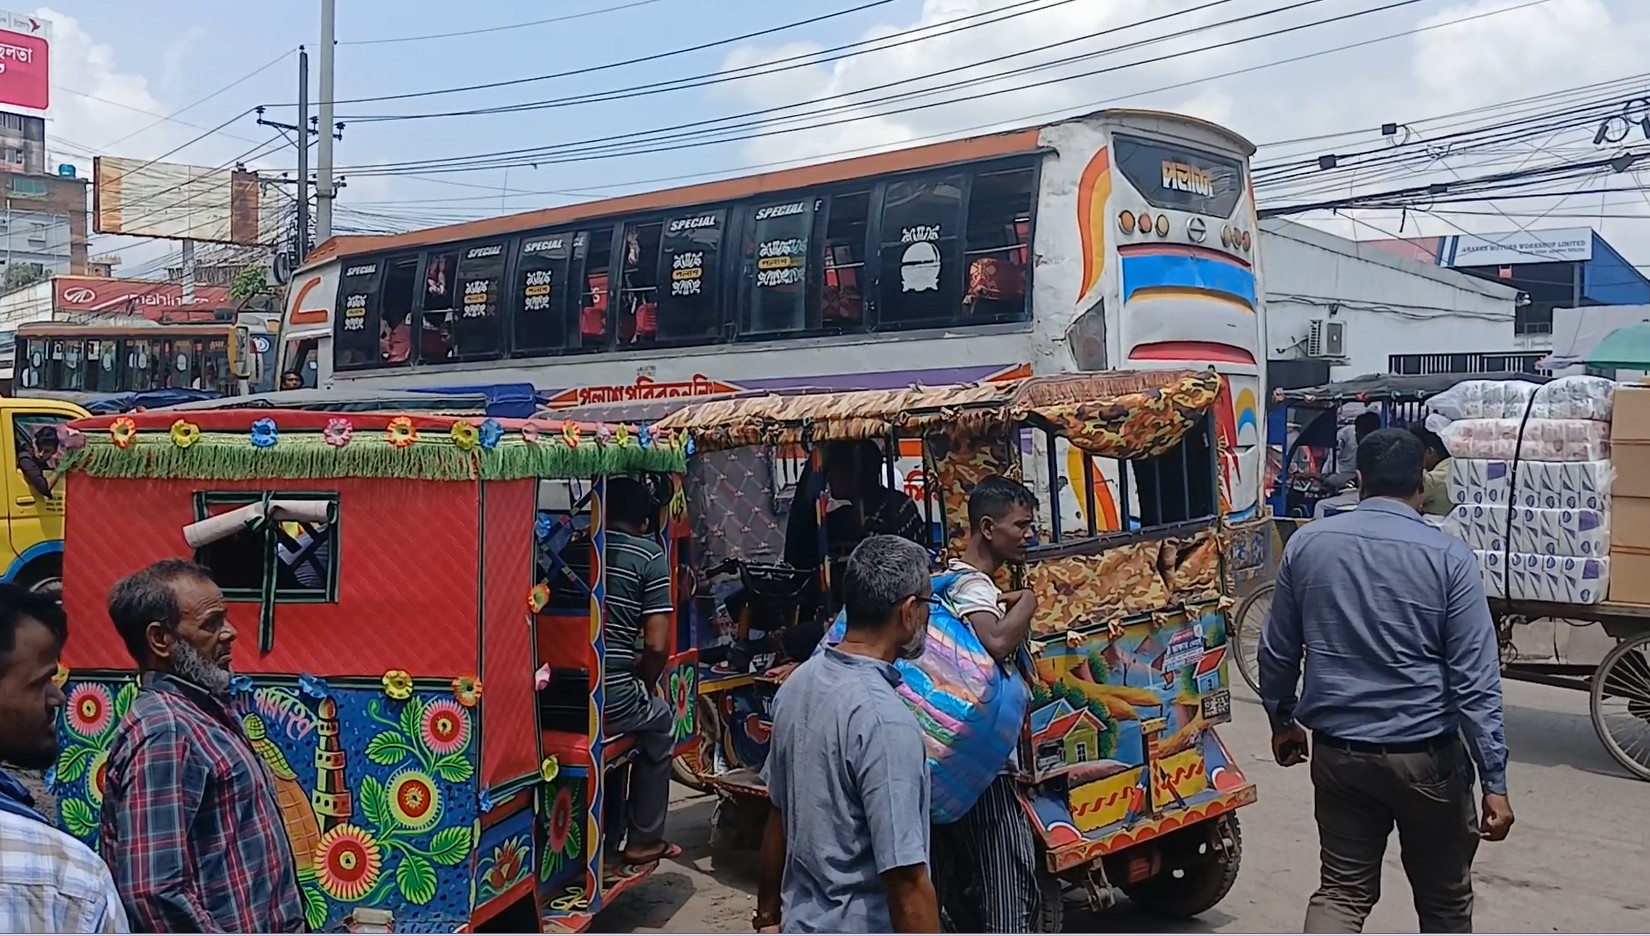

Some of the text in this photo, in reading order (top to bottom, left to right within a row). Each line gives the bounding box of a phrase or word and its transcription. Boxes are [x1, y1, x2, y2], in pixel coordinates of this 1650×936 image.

[755, 202, 805, 220] SPECIAL
[670, 215, 716, 231] SPECIAL
[524, 239, 563, 253] SPECIAL
[1519, 241, 1556, 249] WORKSHOP
[1557, 240, 1586, 248] LIMITED
[467, 245, 502, 258] SPECIAL
[346, 264, 377, 276] SPECIAL
